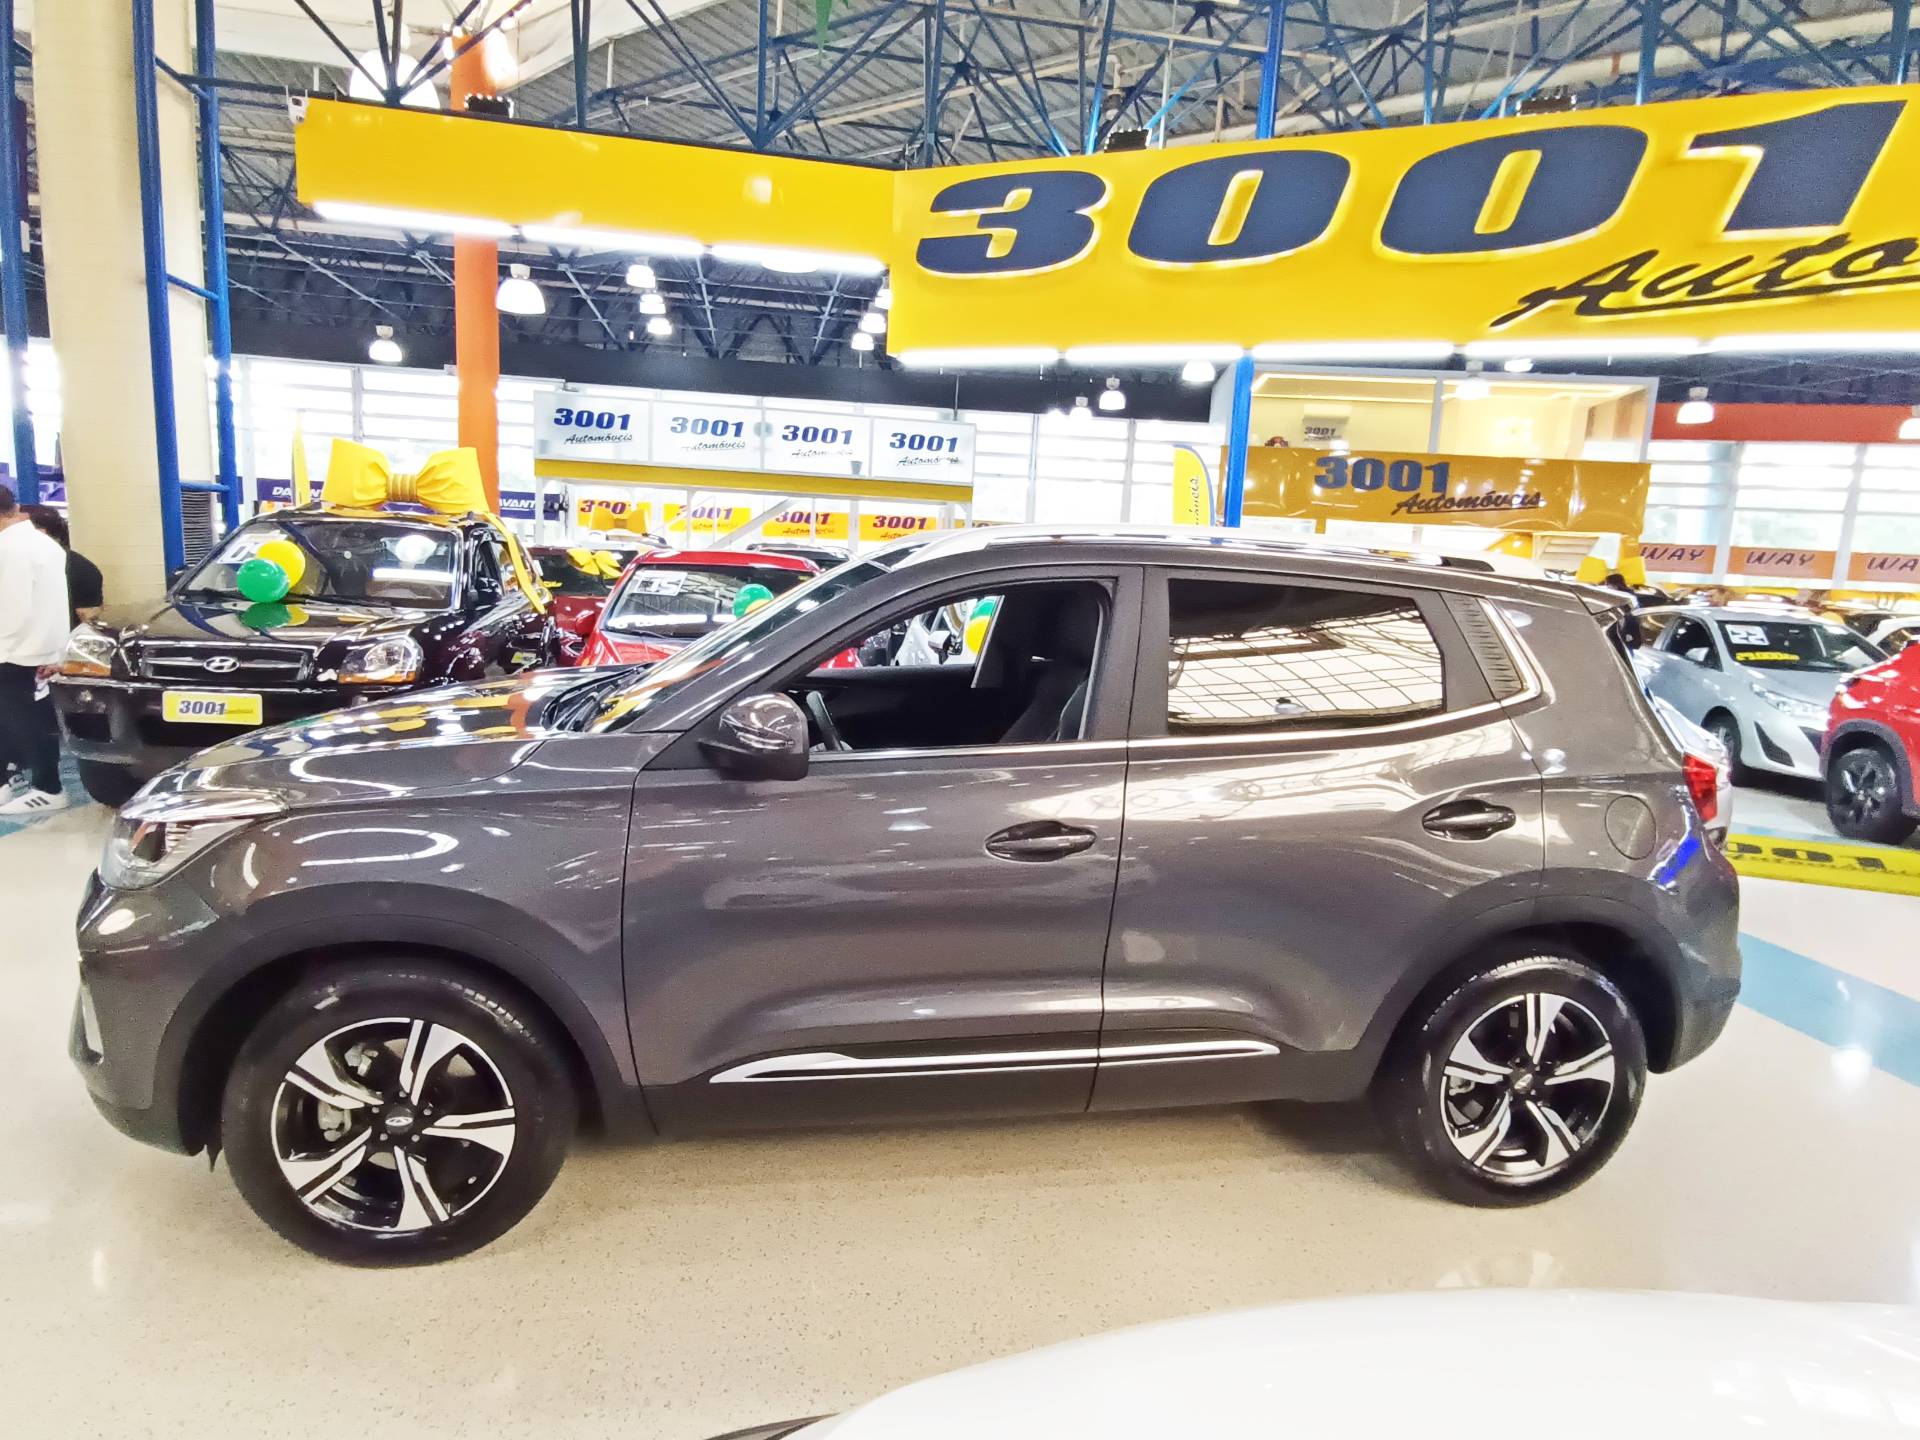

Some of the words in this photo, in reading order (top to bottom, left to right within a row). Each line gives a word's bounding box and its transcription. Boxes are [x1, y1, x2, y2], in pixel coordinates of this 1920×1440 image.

[916, 101, 1905, 275] 3001
[553, 407, 632, 431] 3001
[670, 416, 745, 438] 3001
[781, 424, 853, 445] 3001
[889, 432, 958, 453] 3001
[682, 439, 746, 452] utomóveis
[1313, 455, 1450, 493] 3001
[872, 515, 928, 530] 3001
[1641, 546, 1705, 561] WAY
[1747, 551, 1816, 566] WAY
[179, 700, 226, 715] 3001
[1728, 842, 1887, 872] 001
